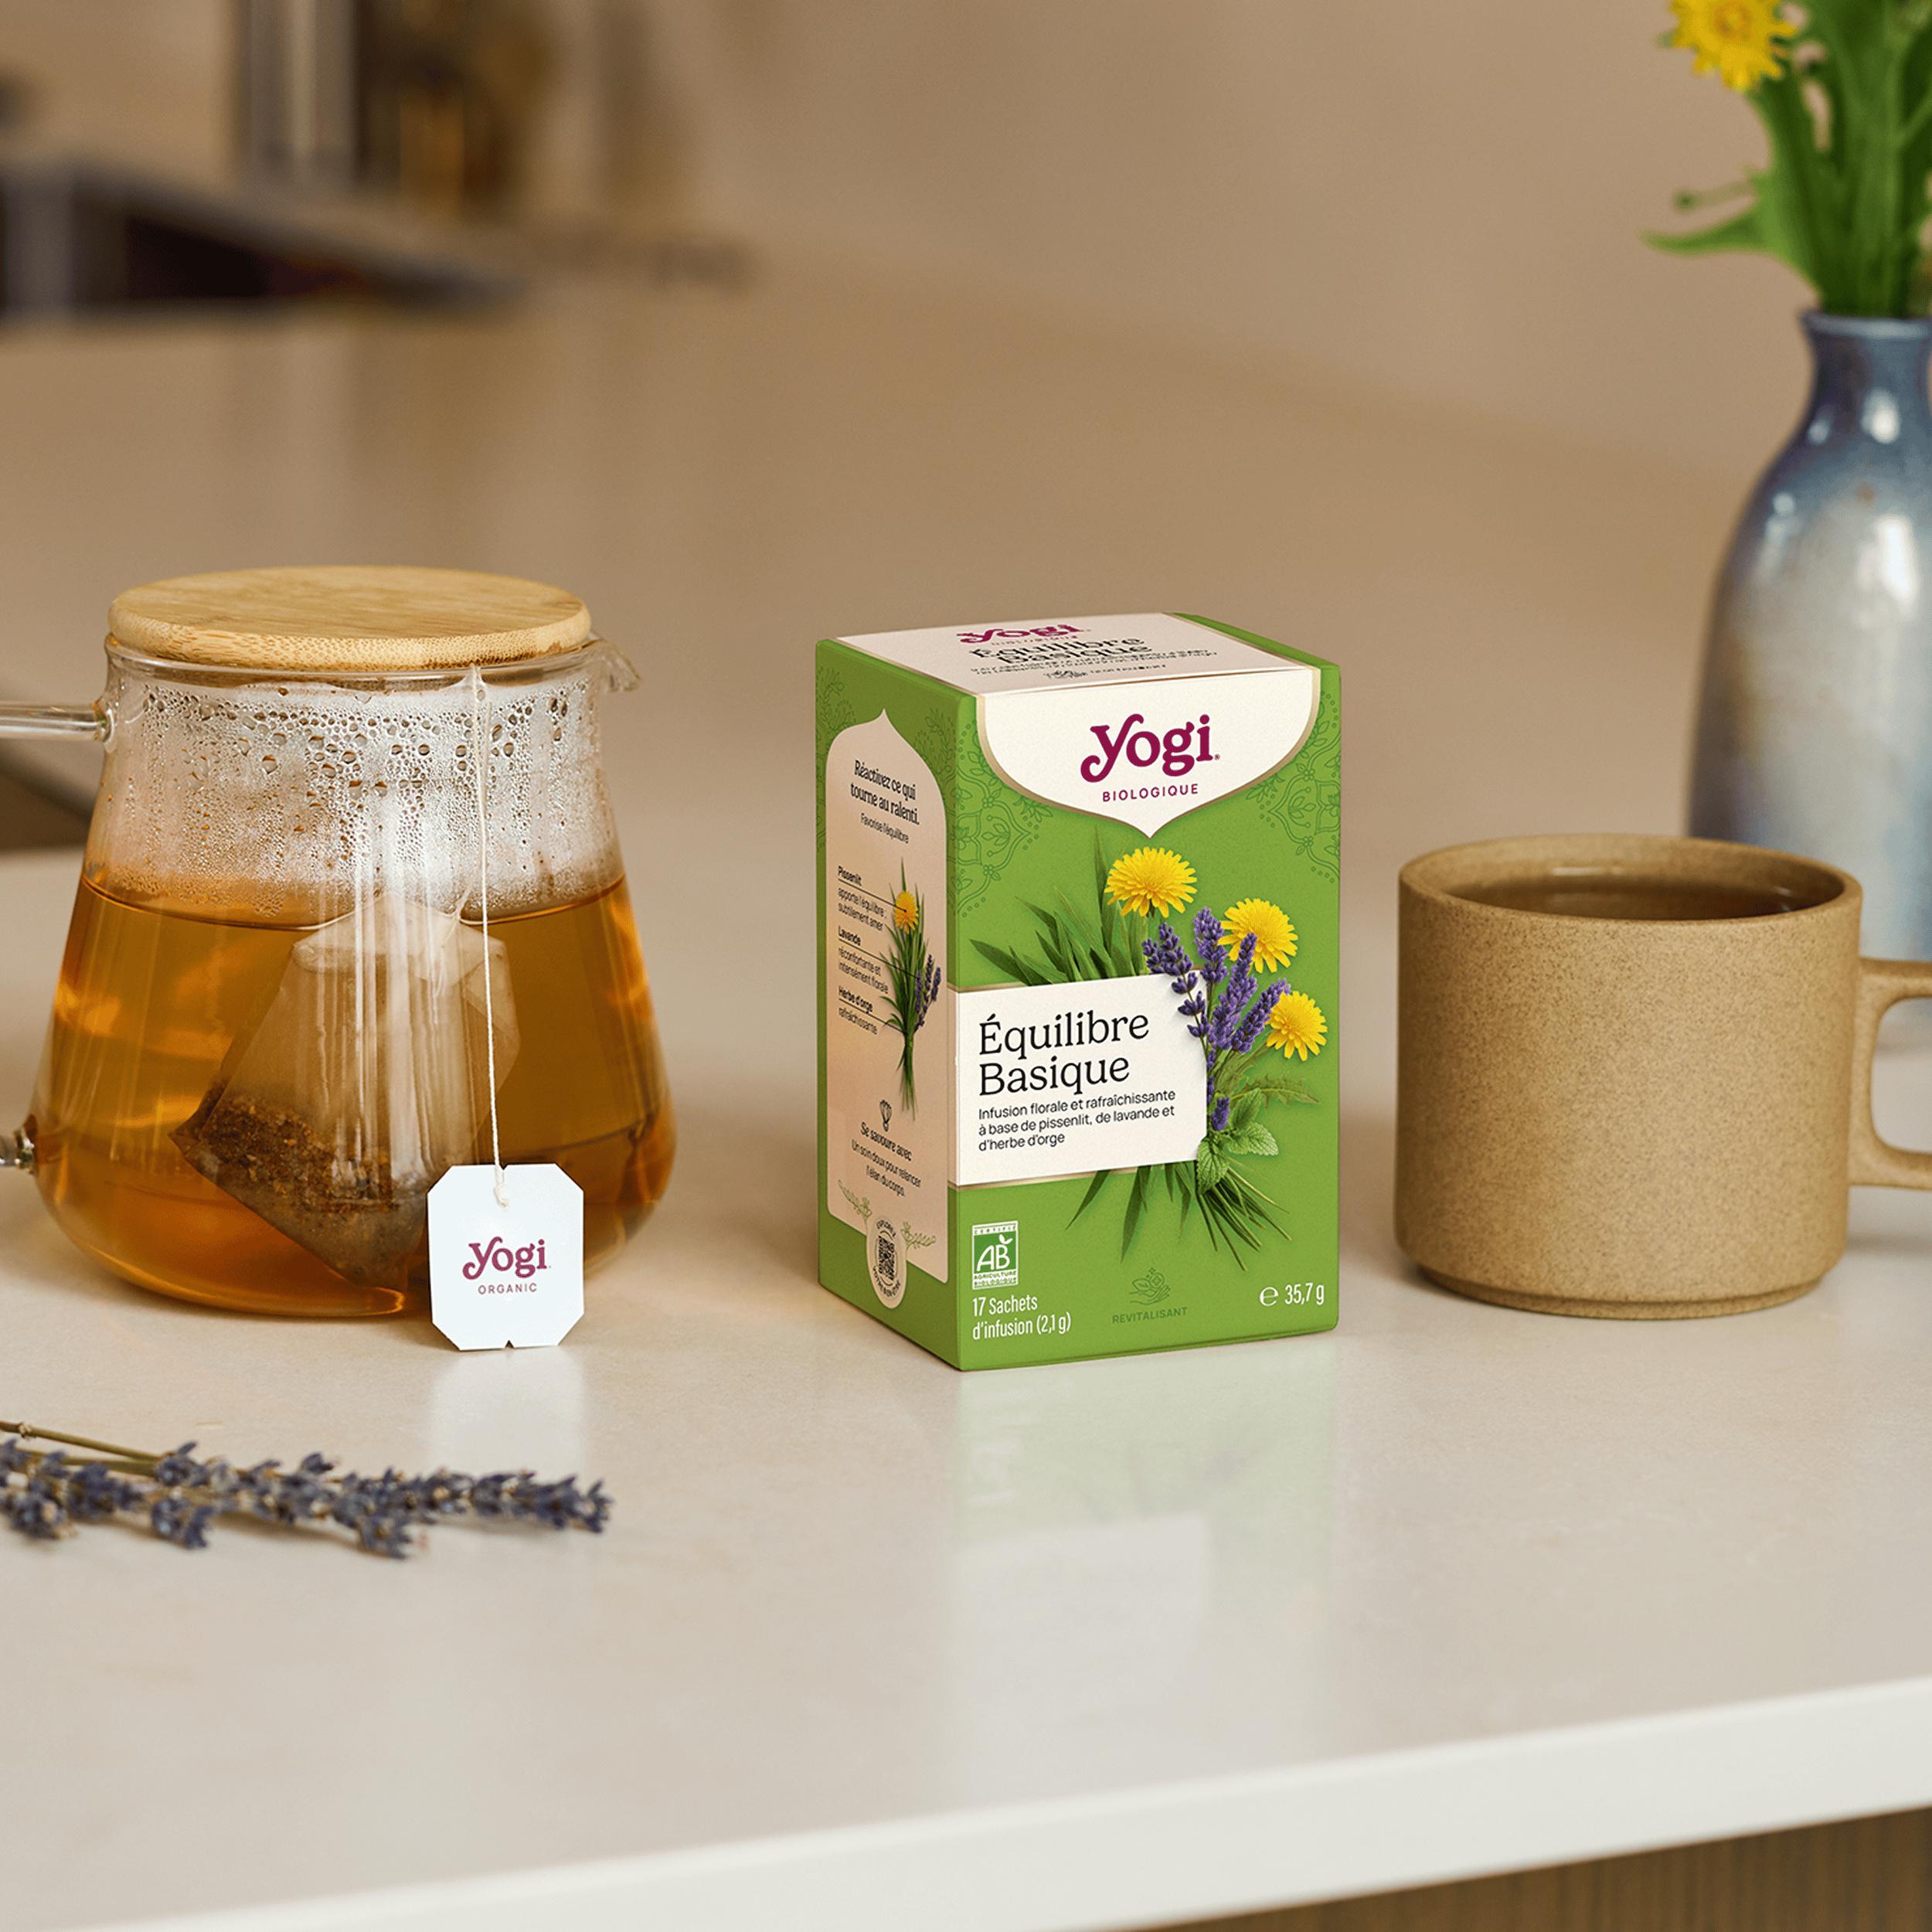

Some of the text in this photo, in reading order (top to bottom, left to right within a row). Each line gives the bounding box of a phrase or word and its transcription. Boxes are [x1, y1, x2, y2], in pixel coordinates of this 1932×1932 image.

[998, 646, 1151, 664] Basique
[854, 760, 916, 801] Réactivez ce qui
[850, 782, 920, 825] tourne au ralenti.
[1102, 784, 1199, 802] BIOLOGIQUE
[861, 813, 883, 833] Favorise
[838, 866, 862, 886] Pissenlit
[838, 925, 861, 946] Lavande
[838, 985, 855, 1003] Herbe
[978, 1010, 1149, 1060] Équilibre
[978, 1056, 1129, 1096] Basique
[978, 1090, 1175, 1120] Infusion florale et rafraîchissante
[860, 1121, 869, 1138] Se
[978, 1105, 1175, 1136] à base de pissenlit, de lavande et
[978, 1133, 1065, 1151] d'herbe d'orge
[976, 1243, 1010, 1272] AB
[478, 1283, 537, 1295] ORGANIC
[1284, 1283, 1313, 1305] 35,7
[1316, 1284, 1325, 1305] g
[972, 1294, 1038, 1317] 17 Sachets
[1112, 1306, 1188, 1324] REVITALISANT
[972, 1317, 1033, 1341] d'infusion
